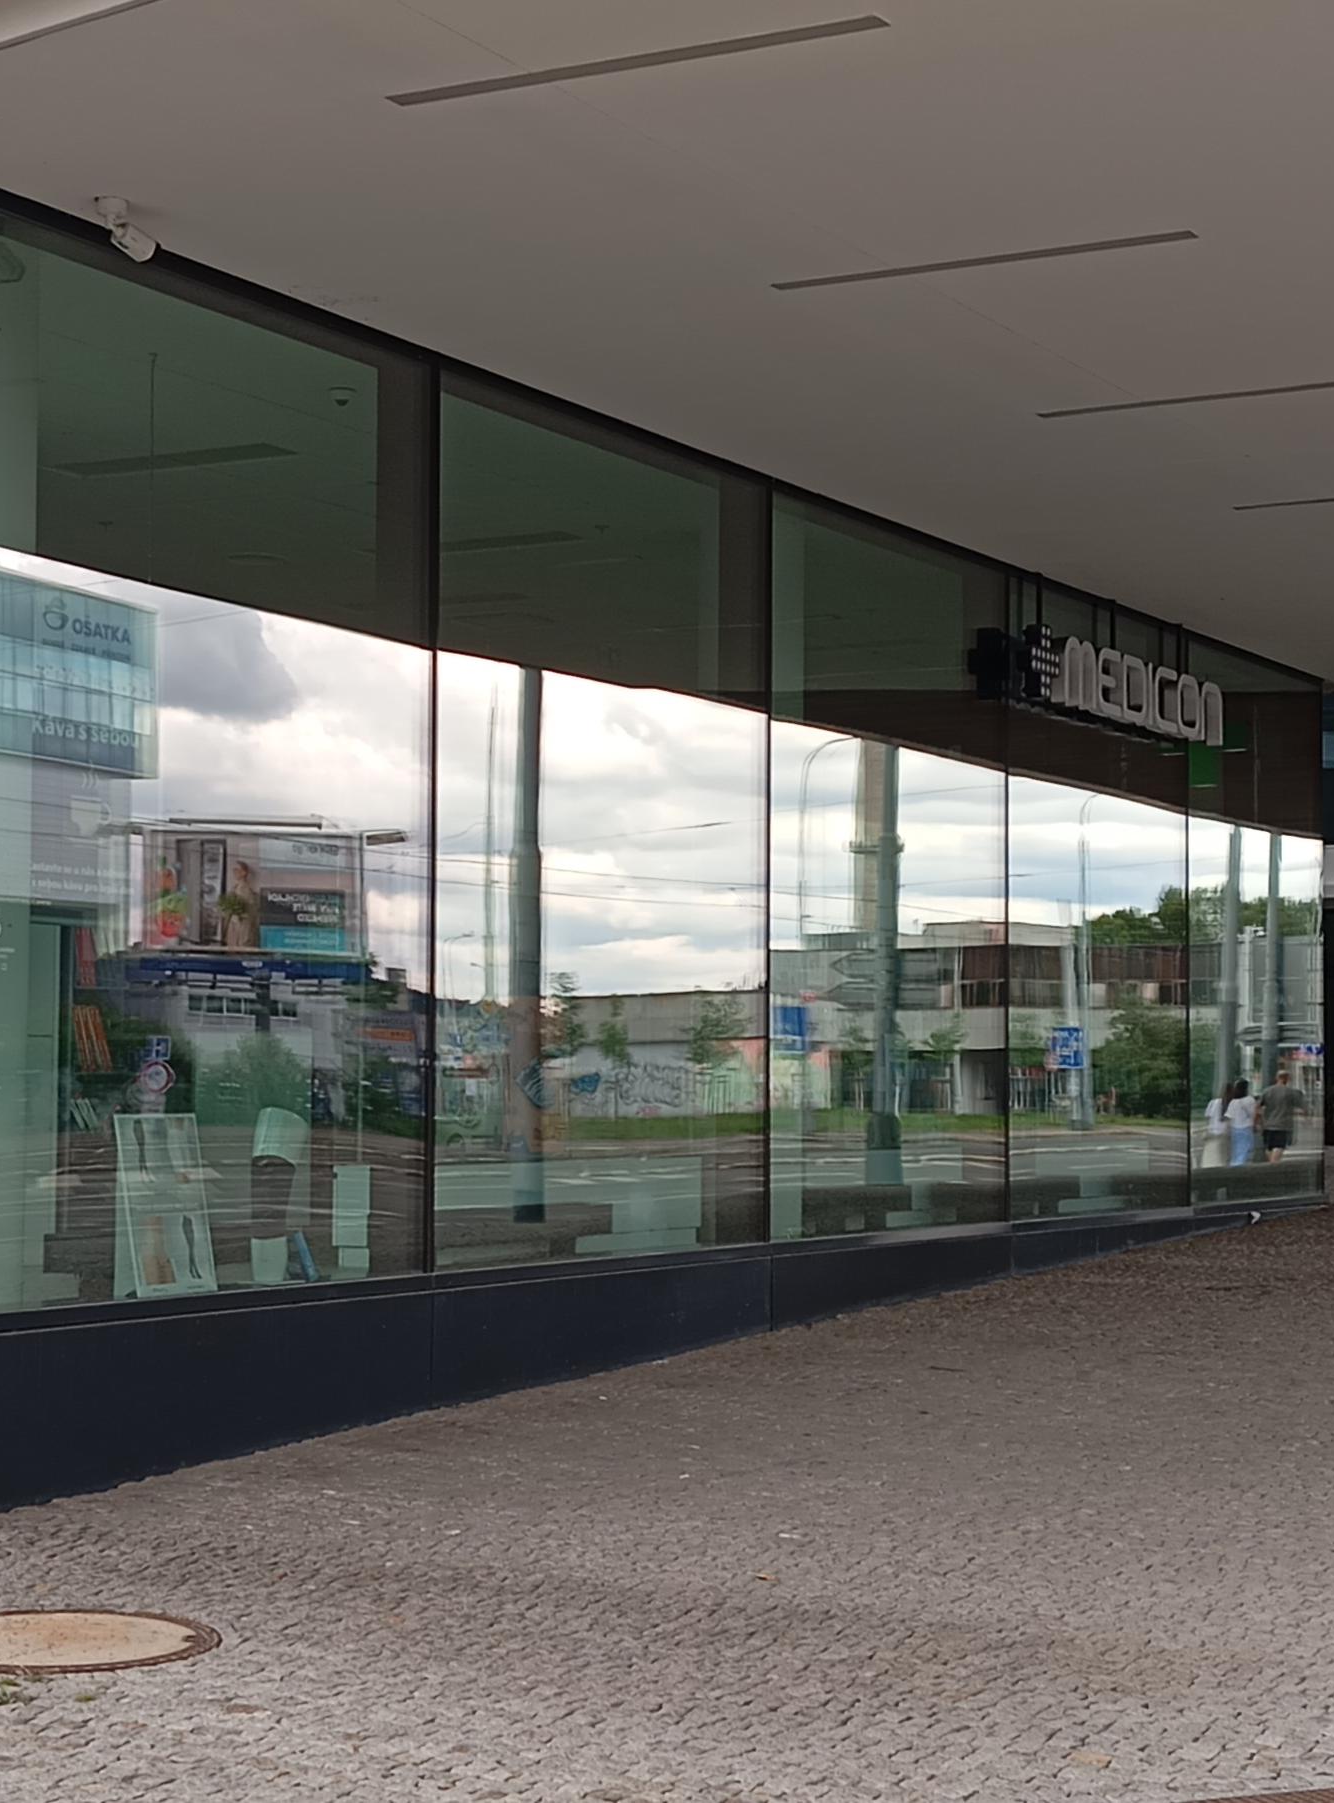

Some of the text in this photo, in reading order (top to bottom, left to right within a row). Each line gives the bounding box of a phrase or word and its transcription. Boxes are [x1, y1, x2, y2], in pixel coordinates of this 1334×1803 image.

[72, 615, 132, 645] OŠATKA
[1064, 636, 1223, 747] MEDICON
[32, 718, 75, 740] Káva
